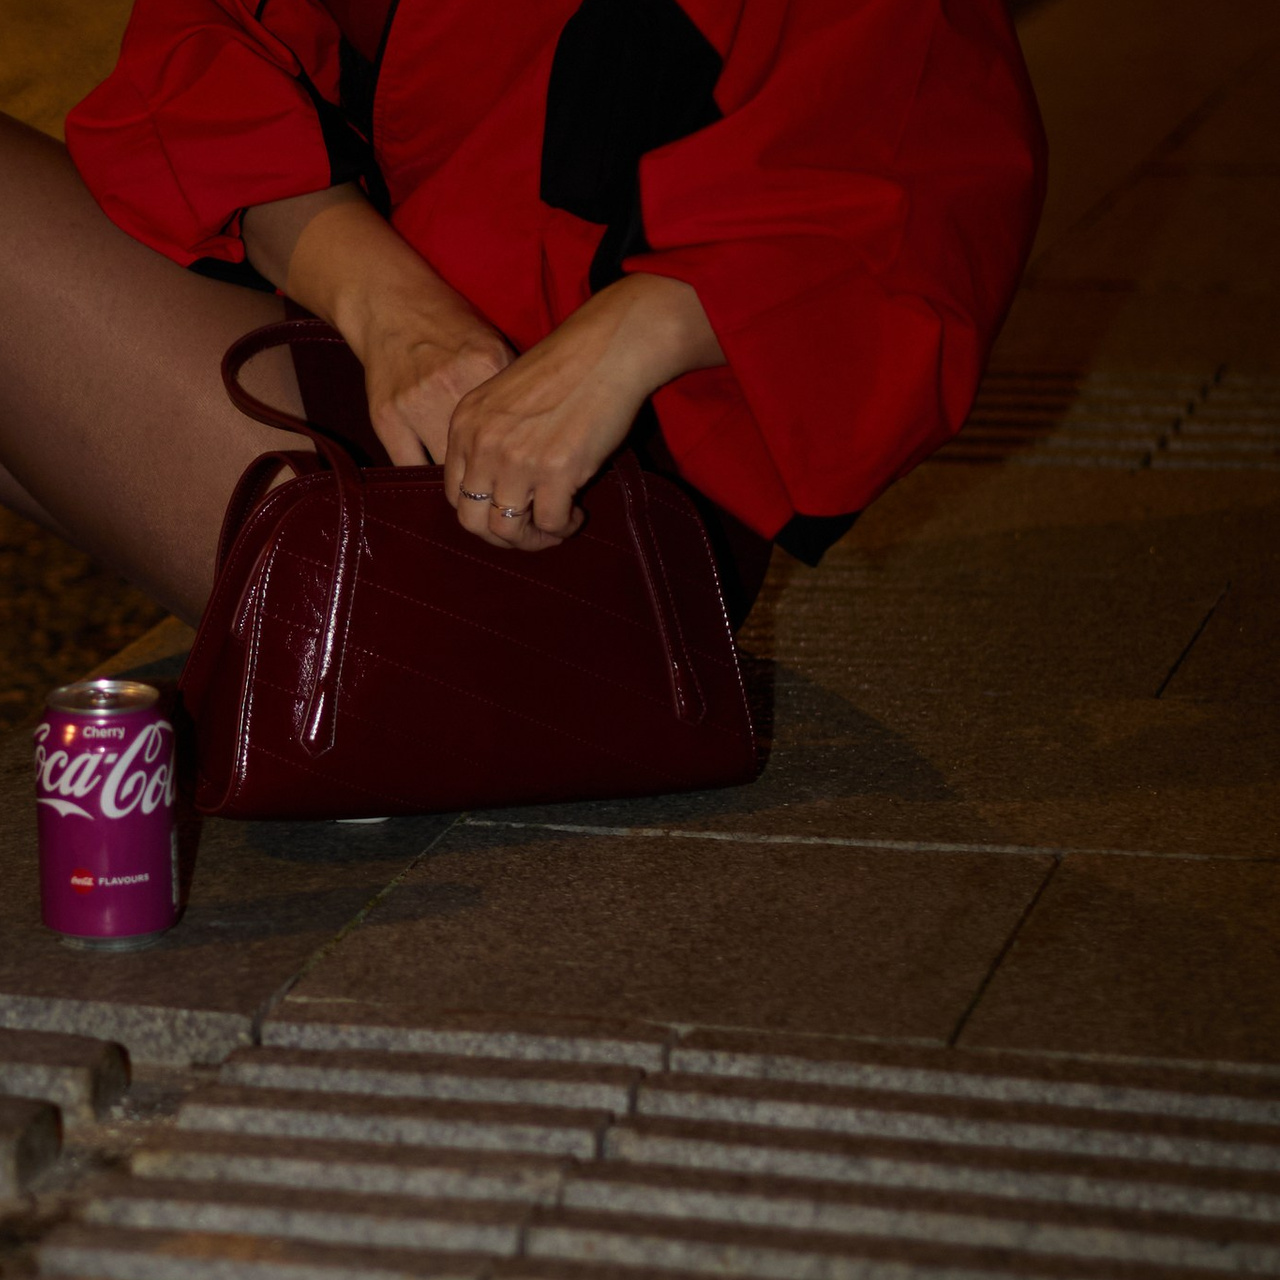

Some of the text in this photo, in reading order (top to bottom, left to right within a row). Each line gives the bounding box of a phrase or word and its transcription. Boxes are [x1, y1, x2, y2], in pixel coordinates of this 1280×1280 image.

[82, 726, 125, 740] Cherry
[34, 720, 176, 819] oca-Col
[98, 872, 150, 887] FLAVOURS
